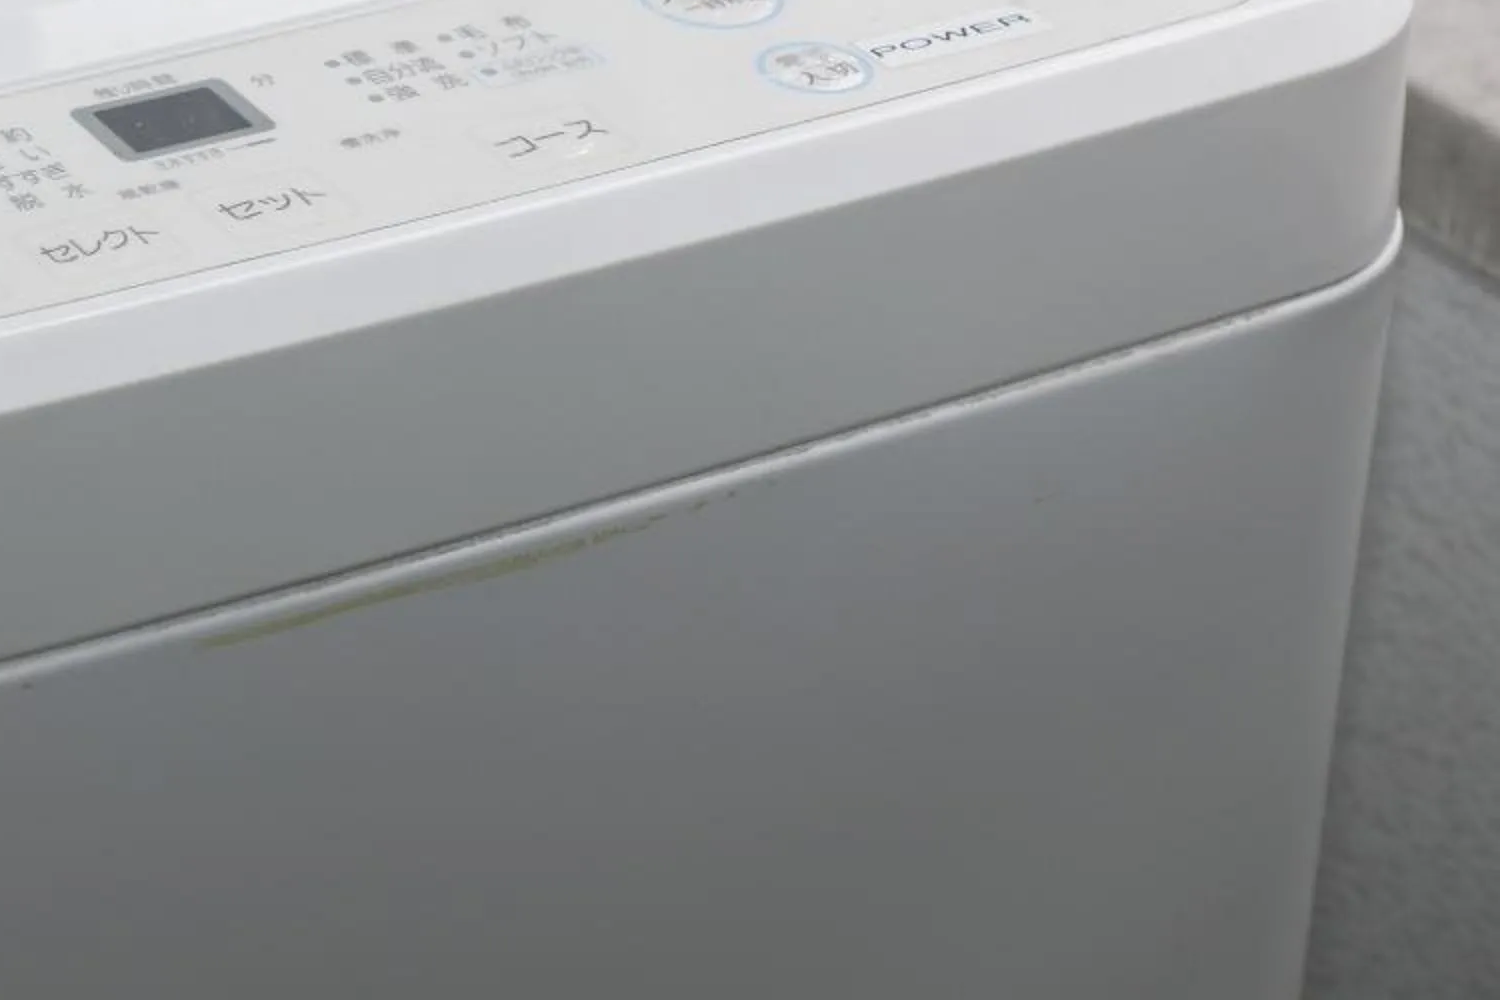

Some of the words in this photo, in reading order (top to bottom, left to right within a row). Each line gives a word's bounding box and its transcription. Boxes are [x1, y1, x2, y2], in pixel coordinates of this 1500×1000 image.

[869, 10, 1034, 60] POWER
[493, 118, 609, 159] コース
[218, 186, 327, 221] セット
[39, 225, 160, 264] セレクト
